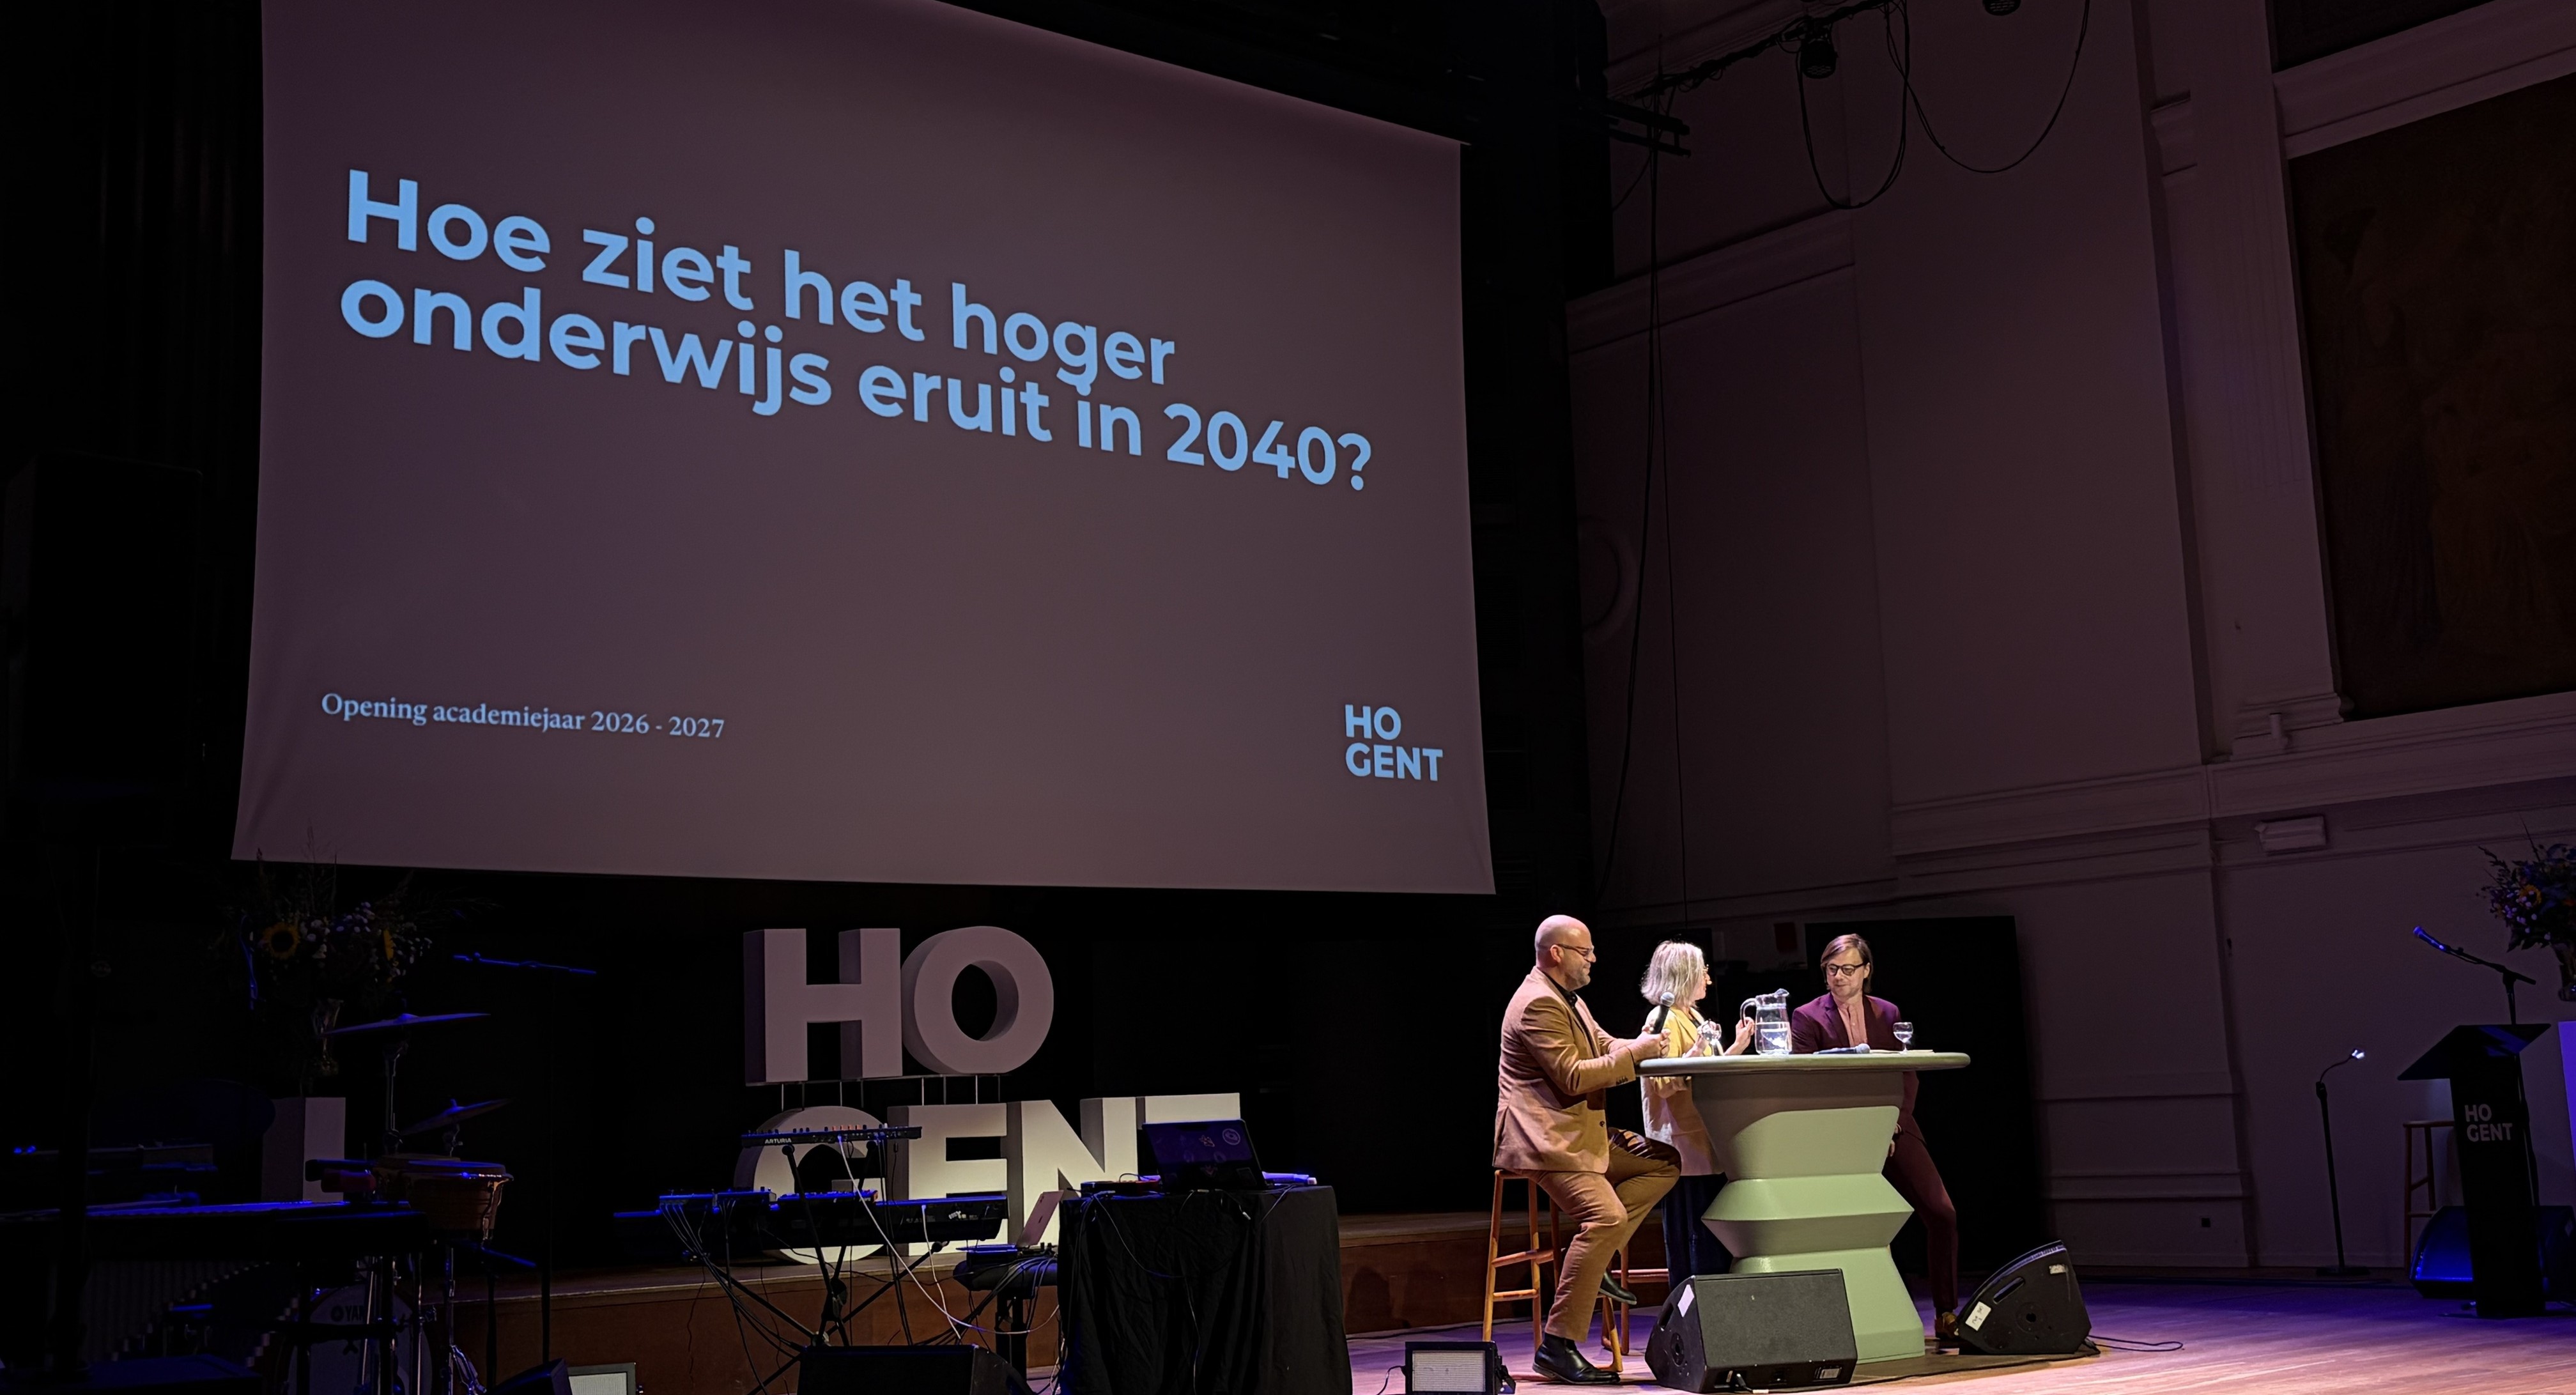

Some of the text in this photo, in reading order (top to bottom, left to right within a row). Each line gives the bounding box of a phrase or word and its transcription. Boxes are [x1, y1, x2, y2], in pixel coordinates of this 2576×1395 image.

[348, 169, 1175, 387] Hoe ziet het hoger
[341, 280, 1371, 491] onderwijs eruit in 2040?
[321, 693, 428, 726] Opening
[433, 703, 585, 731] academiejaar
[591, 712, 649, 734] 2026
[670, 716, 725, 738] 2027
[1345, 704, 1401, 741] HO
[1345, 742, 1443, 782] GENT
[743, 925, 1054, 1085] HO
[2464, 1103, 2493, 1122] HO
[2466, 1122, 2513, 1143] GENT
